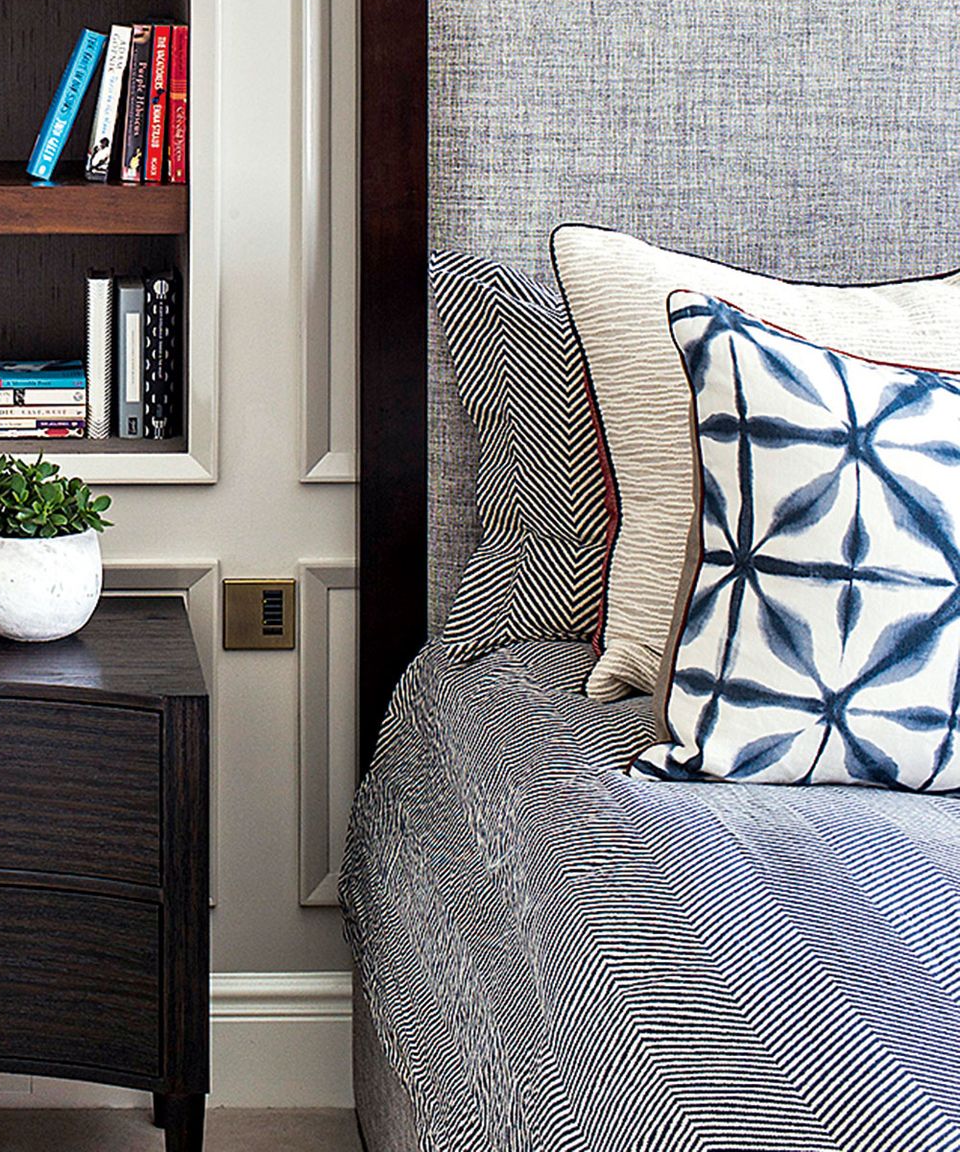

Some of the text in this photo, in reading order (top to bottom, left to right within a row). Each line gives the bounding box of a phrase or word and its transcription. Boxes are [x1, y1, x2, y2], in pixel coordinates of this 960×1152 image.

[117, 39, 127, 69] ADAM
[157, 36, 167, 48] THE
[133, 62, 148, 137] Purple Hibiscus
